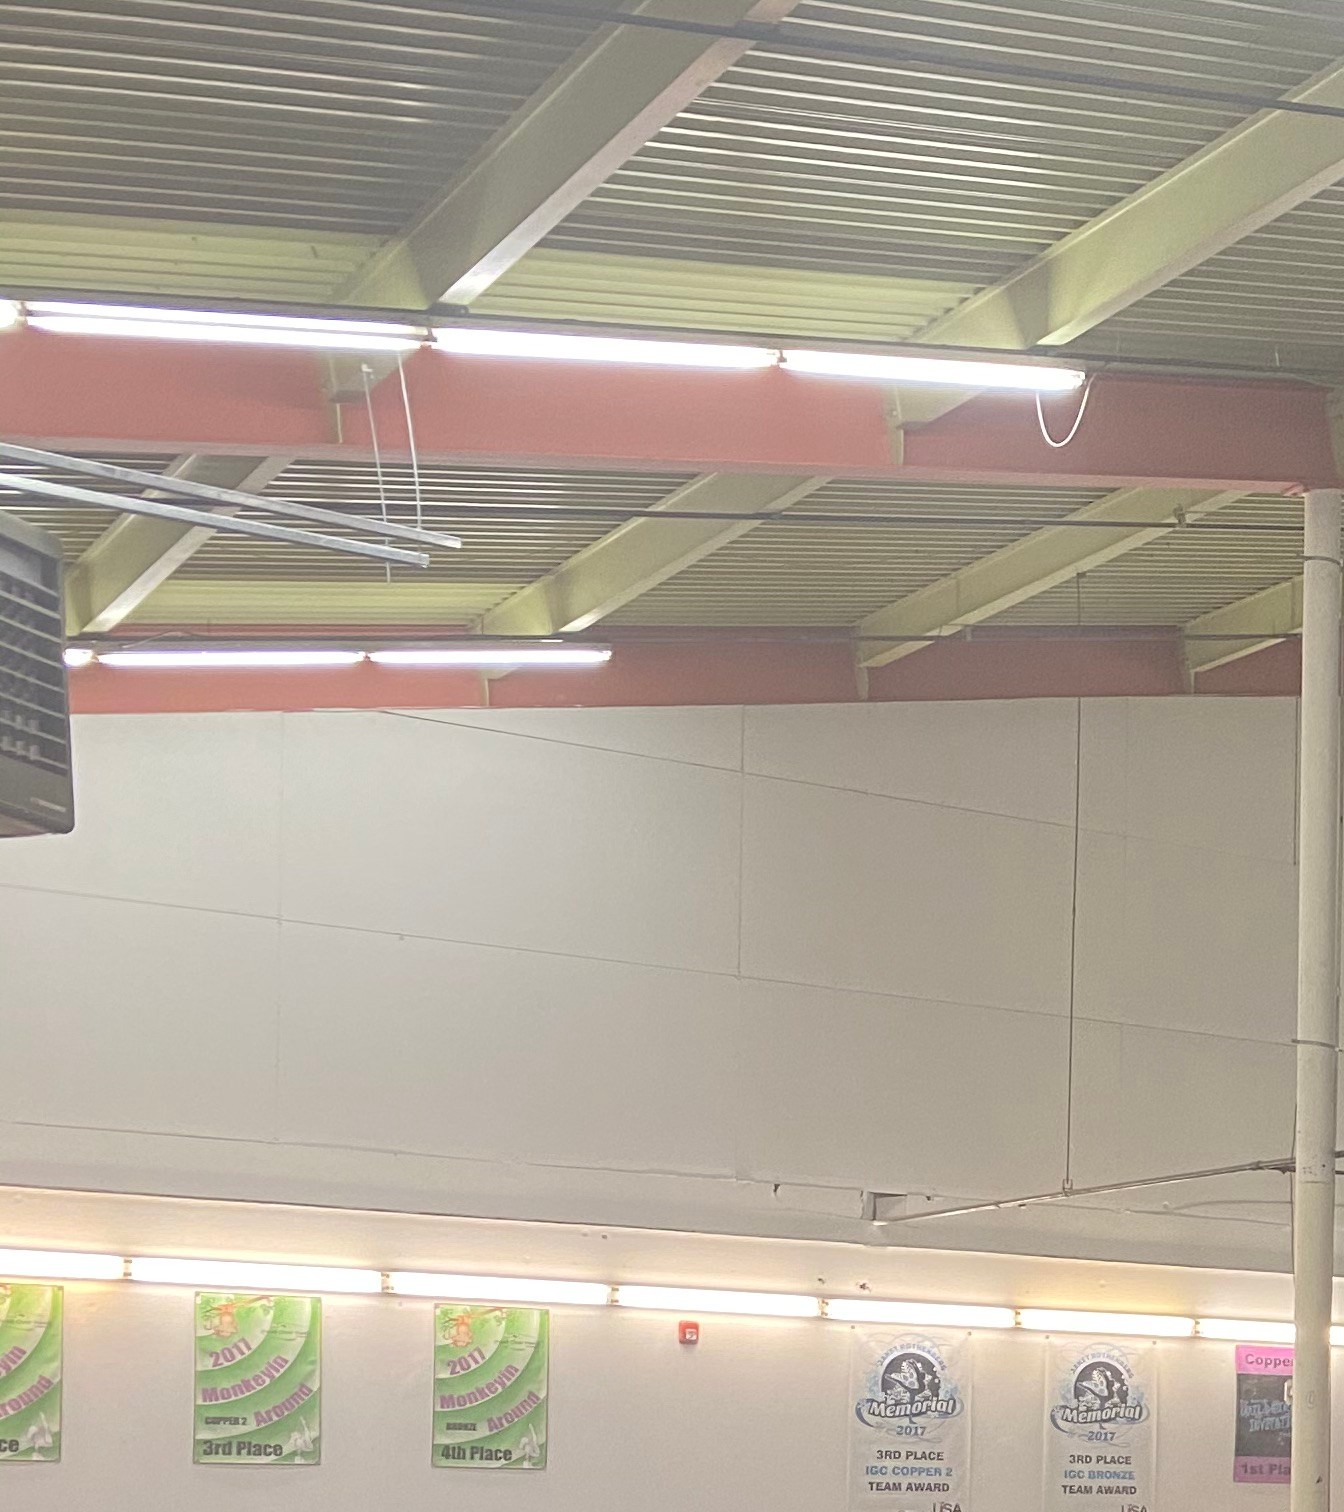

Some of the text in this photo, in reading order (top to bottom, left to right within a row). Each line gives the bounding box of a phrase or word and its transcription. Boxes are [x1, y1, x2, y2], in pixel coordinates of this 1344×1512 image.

[211, 1337, 252, 1368] 2017
[448, 1346, 486, 1375] 2017
[202, 1355, 289, 1403] Monkeyin
[440, 1364, 519, 1409] Monkeyin
[253, 1383, 314, 1427] Around
[487, 1391, 541, 1432] Around
[869, 1398, 956, 1418] Memorial
[1061, 1404, 1142, 1424] Memorial
[896, 1426, 926, 1436] 2017
[1088, 1431, 1116, 1441] 2017
[203, 1440, 283, 1457] 3rd Place
[441, 1446, 512, 1461] 4th Place
[876, 1450, 944, 1460] 3RD PLACE
[1069, 1455, 1131, 1465] 3RD PLACE
[865, 1466, 953, 1476] IGC COPPER 2
[1064, 1469, 1135, 1480] IGC BRONZE
[1269, 1464, 1291, 1475] Pla
[868, 1482, 950, 1492] TEAM AWARD
[1061, 1485, 1137, 1495] TEAM AWARD
